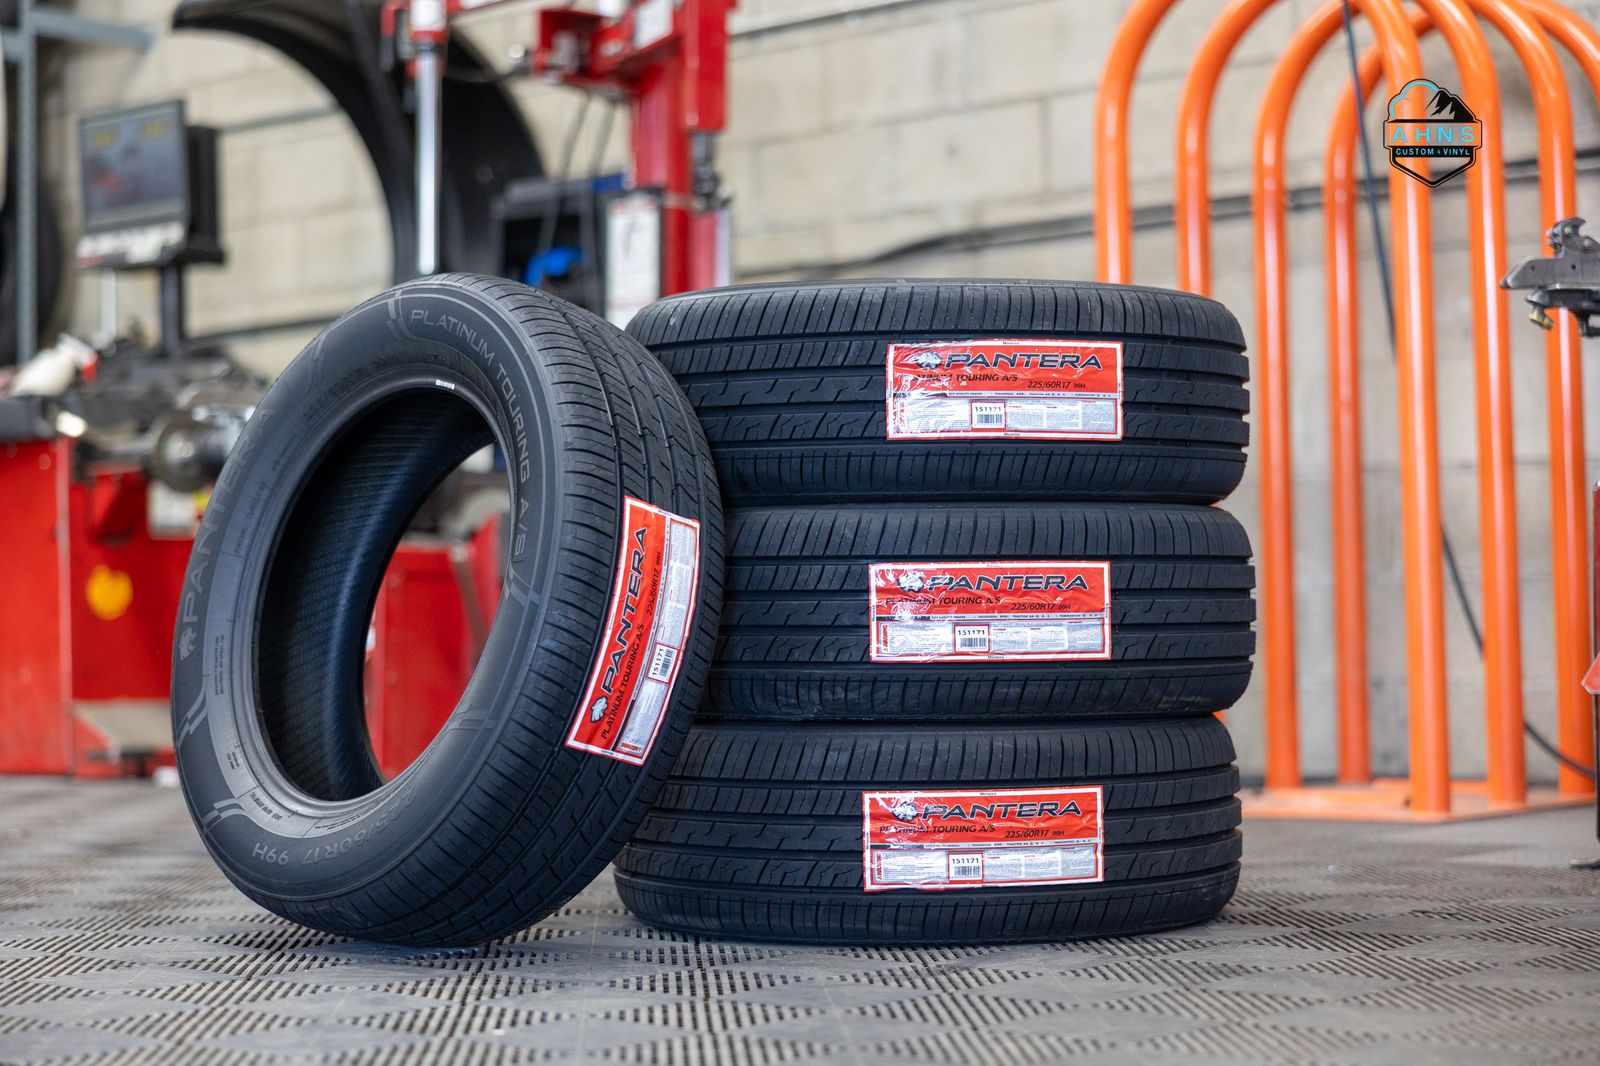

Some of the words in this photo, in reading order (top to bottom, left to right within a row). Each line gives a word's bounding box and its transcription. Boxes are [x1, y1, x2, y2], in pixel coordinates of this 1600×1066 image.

[944, 351, 1103, 371] PANTERA
[956, 373, 1000, 382] TOURING
[1001, 373, 1018, 382] A/S
[1027, 380, 1071, 389] 225/60R17
[974, 405, 1002, 413] 151171
[410, 309, 496, 366] PLATINUM
[496, 362, 530, 484] TOURING
[514, 498, 530, 556] A/S
[183, 408, 280, 624] PANTERA
[928, 574, 1089, 591] PANTERA
[646, 568, 662, 617] 225/60R17
[938, 596, 983, 605] TOURING
[601, 526, 648, 695] PANTERA
[1010, 602, 1056, 611] 225/60R17
[652, 648, 665, 676] 151171
[601, 690, 625, 739] PLATINUM
[620, 641, 639, 690] TOURING
[634, 624, 645, 641] A/S
[922, 800, 1083, 820] PANTERA
[932, 824, 977, 833] TOURING
[978, 824, 996, 832] A/S
[1004, 829, 1050, 839] 225/60R17
[251, 842, 290, 866] 99H
[951, 857, 980, 865] 151171
